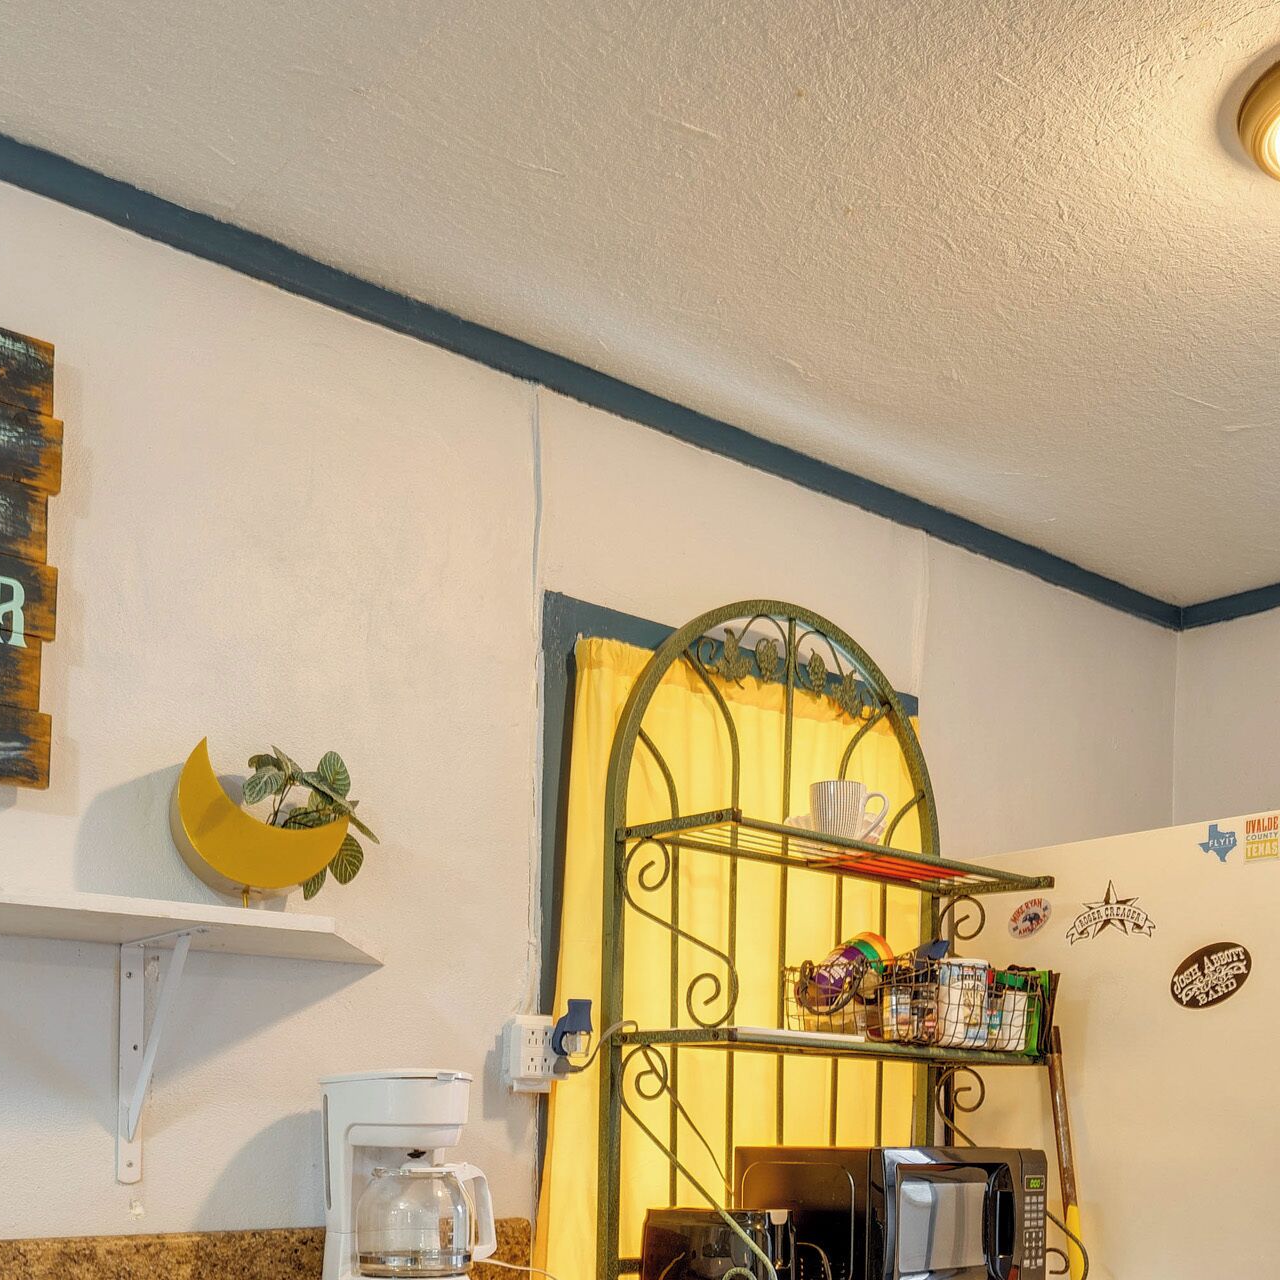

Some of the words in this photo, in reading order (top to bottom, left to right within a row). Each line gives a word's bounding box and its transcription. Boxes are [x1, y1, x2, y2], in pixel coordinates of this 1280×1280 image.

[1246, 816, 1279, 834] UVALDE
[1246, 832, 1278, 841] COUNTY
[1246, 840, 1278, 858] TEXAS
[1011, 904, 1025, 924] MIKE
[1024, 898, 1043, 910] RYAN
[1079, 909, 1103, 928] ROGER
[1104, 906, 1142, 922] CREAGER
[1173, 963, 1202, 995] JOSH
[1203, 947, 1245, 974] ABBOTT
[1196, 978, 1238, 1006] BAND
